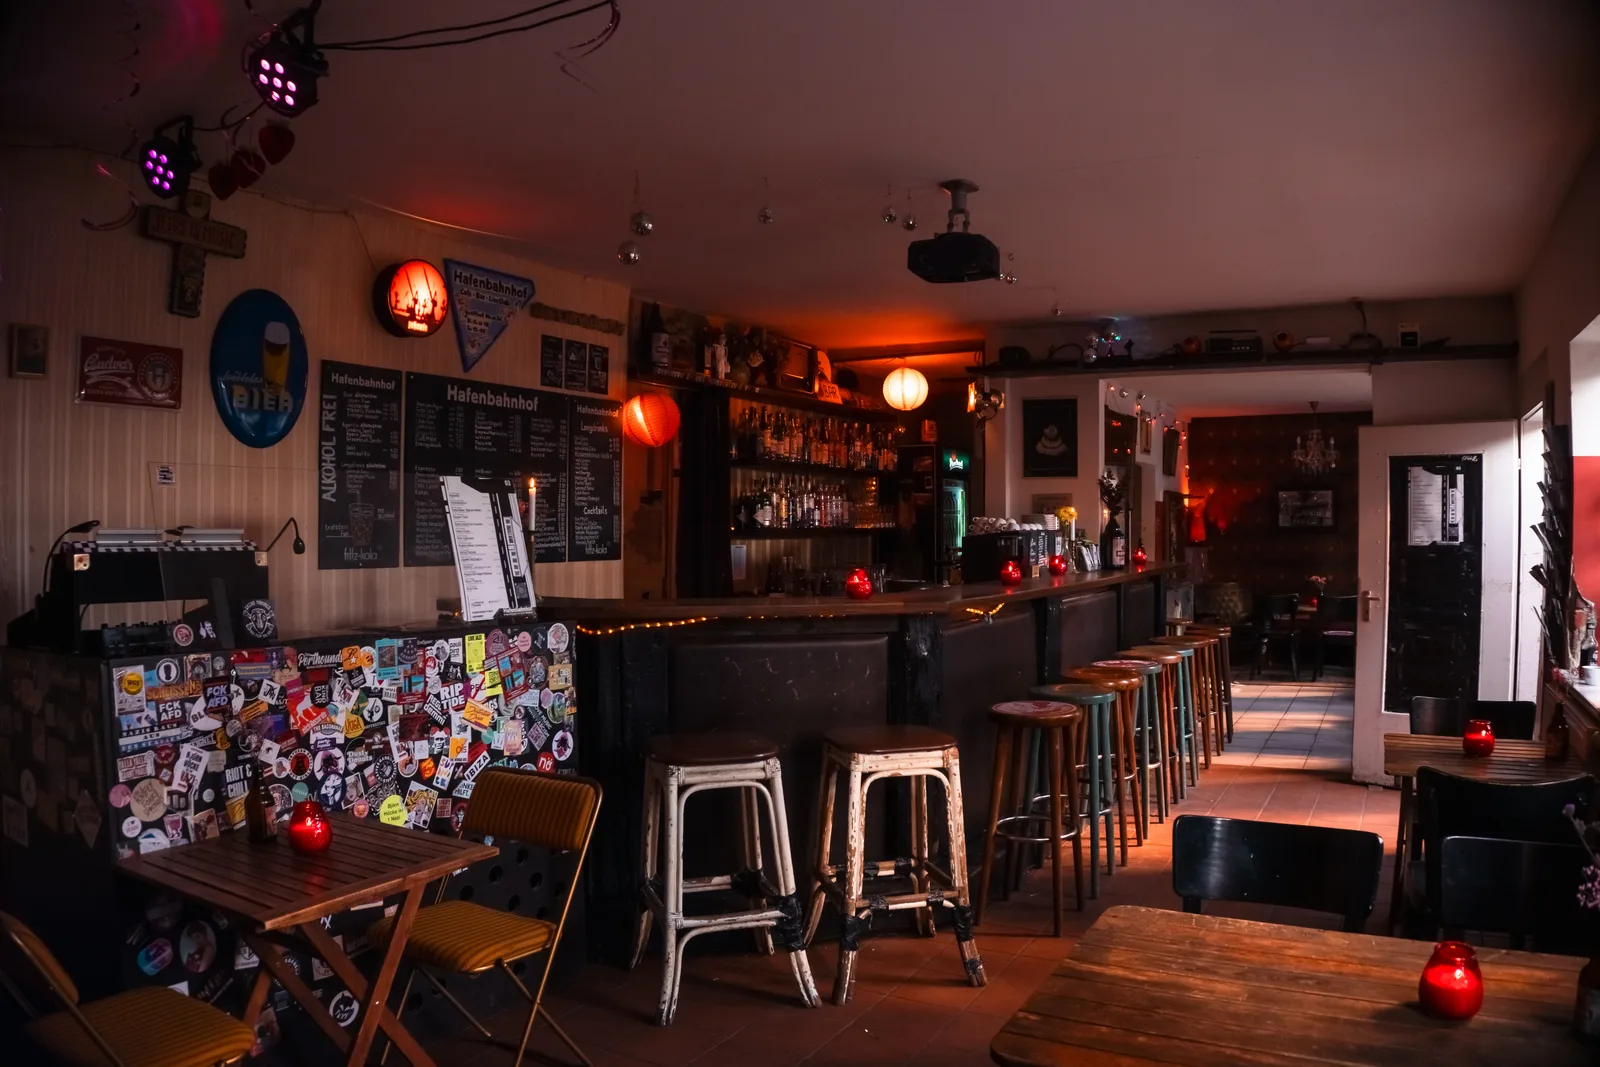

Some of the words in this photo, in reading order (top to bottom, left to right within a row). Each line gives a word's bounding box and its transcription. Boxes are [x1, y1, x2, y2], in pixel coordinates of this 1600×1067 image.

[453, 270, 527, 299] Hafenbahnhof
[331, 373, 396, 390] Hafenbahnhof
[447, 384, 539, 412] Hafenbahnhof
[321, 394, 338, 432] FREI
[577, 404, 619, 417] Hafenbahnhof
[320, 435, 337, 502] ALKOHOL
[583, 506, 608, 515] Cocktails
[344, 547, 378, 561] fritz-kola
[206, 685, 228, 697] FCK
[440, 682, 464, 700] RIP
[159, 700, 182, 713] FCK
[207, 696, 229, 708] AFD
[441, 695, 465, 710] TIDE
[160, 710, 183, 722] AFD
[121, 727, 152, 738] NAZIS
[153, 722, 178, 733] RAUS
[143, 732, 160, 740] AUS
[225, 765, 244, 783] RIOT
[465, 754, 489, 781] IBIZA
[227, 780, 249, 798] CHILL
